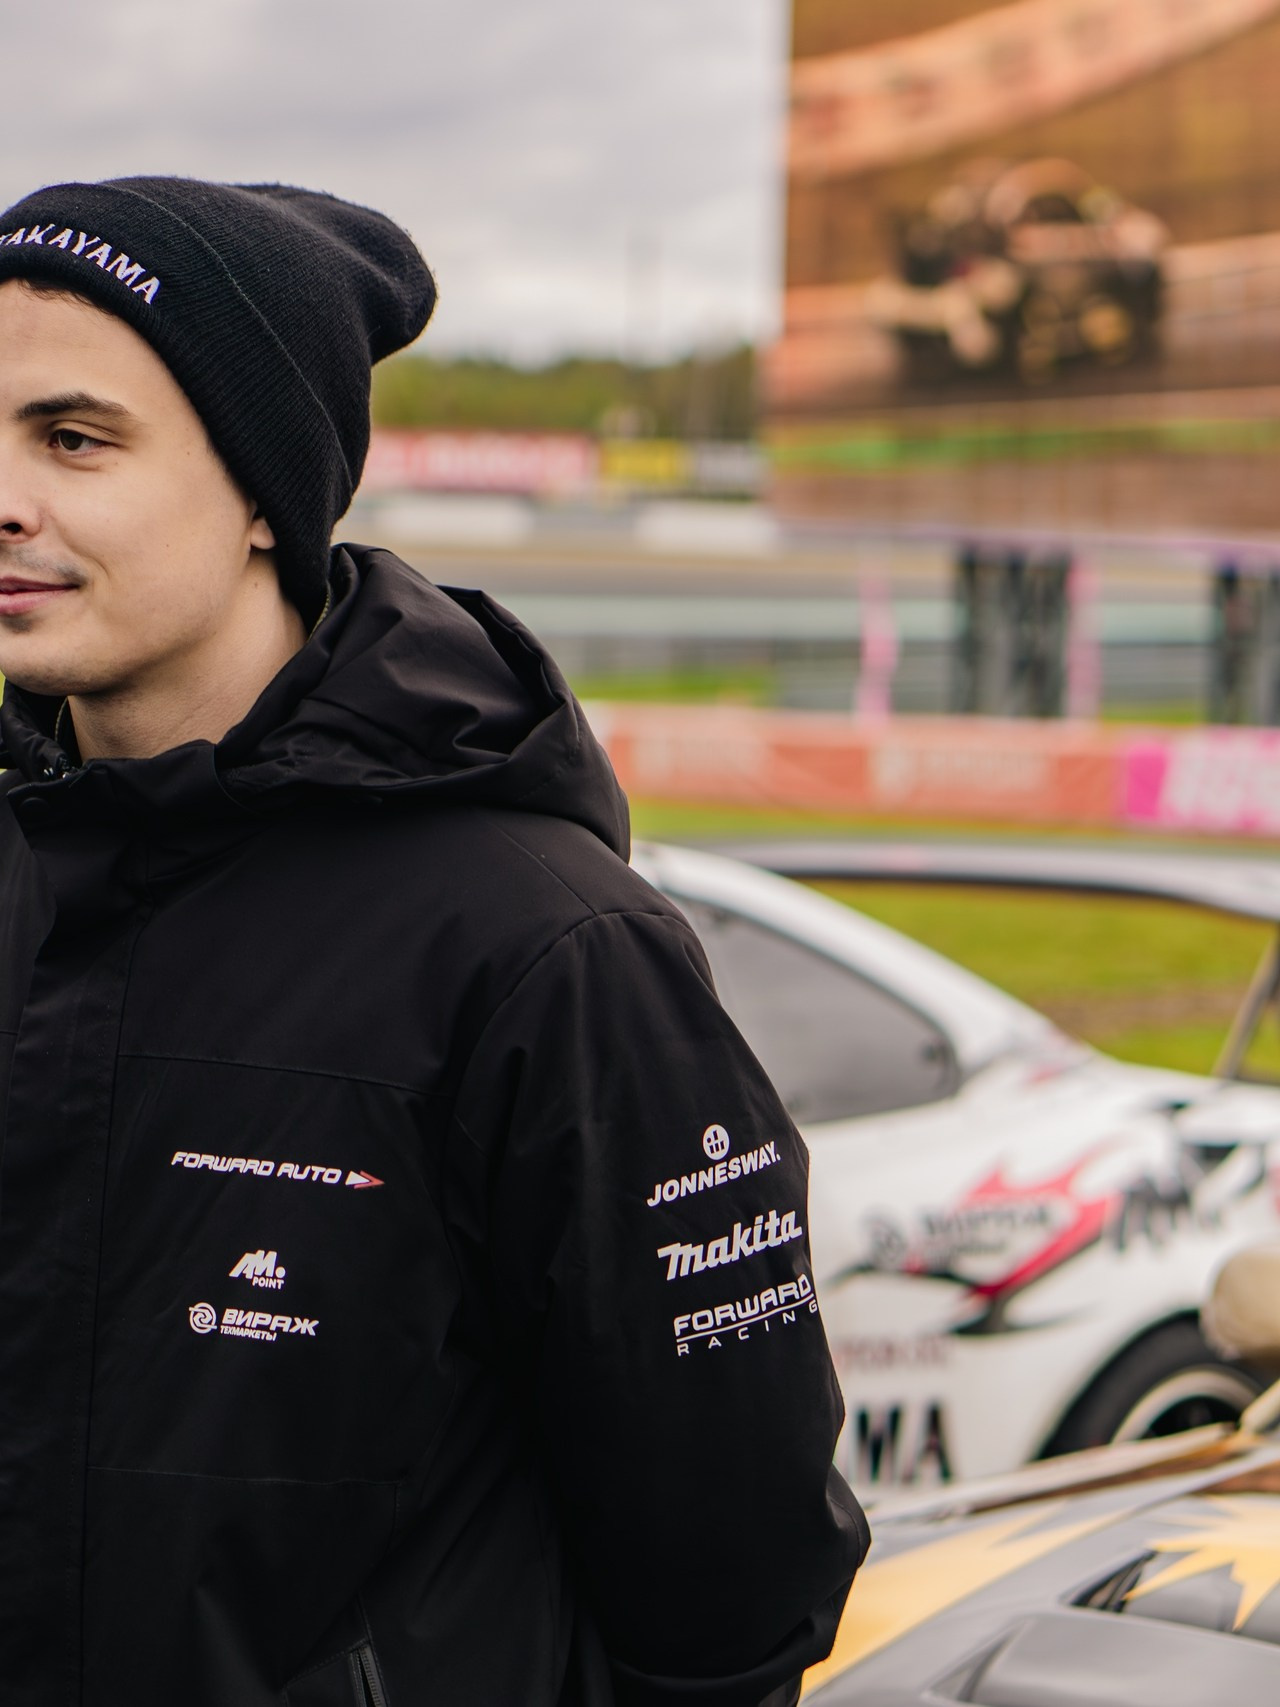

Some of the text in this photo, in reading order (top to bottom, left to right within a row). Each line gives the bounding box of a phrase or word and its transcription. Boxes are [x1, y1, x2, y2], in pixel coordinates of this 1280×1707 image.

[171, 1151, 342, 1184] FORWARD AUTO
[252, 1276, 284, 1289] POINT
[673, 1273, 812, 1336] FORWARD
[220, 1325, 277, 1341] ТЕХМАРКЕТЫ
[221, 1308, 320, 1337] ВИРАЖ
[676, 1299, 818, 1357] RACING
